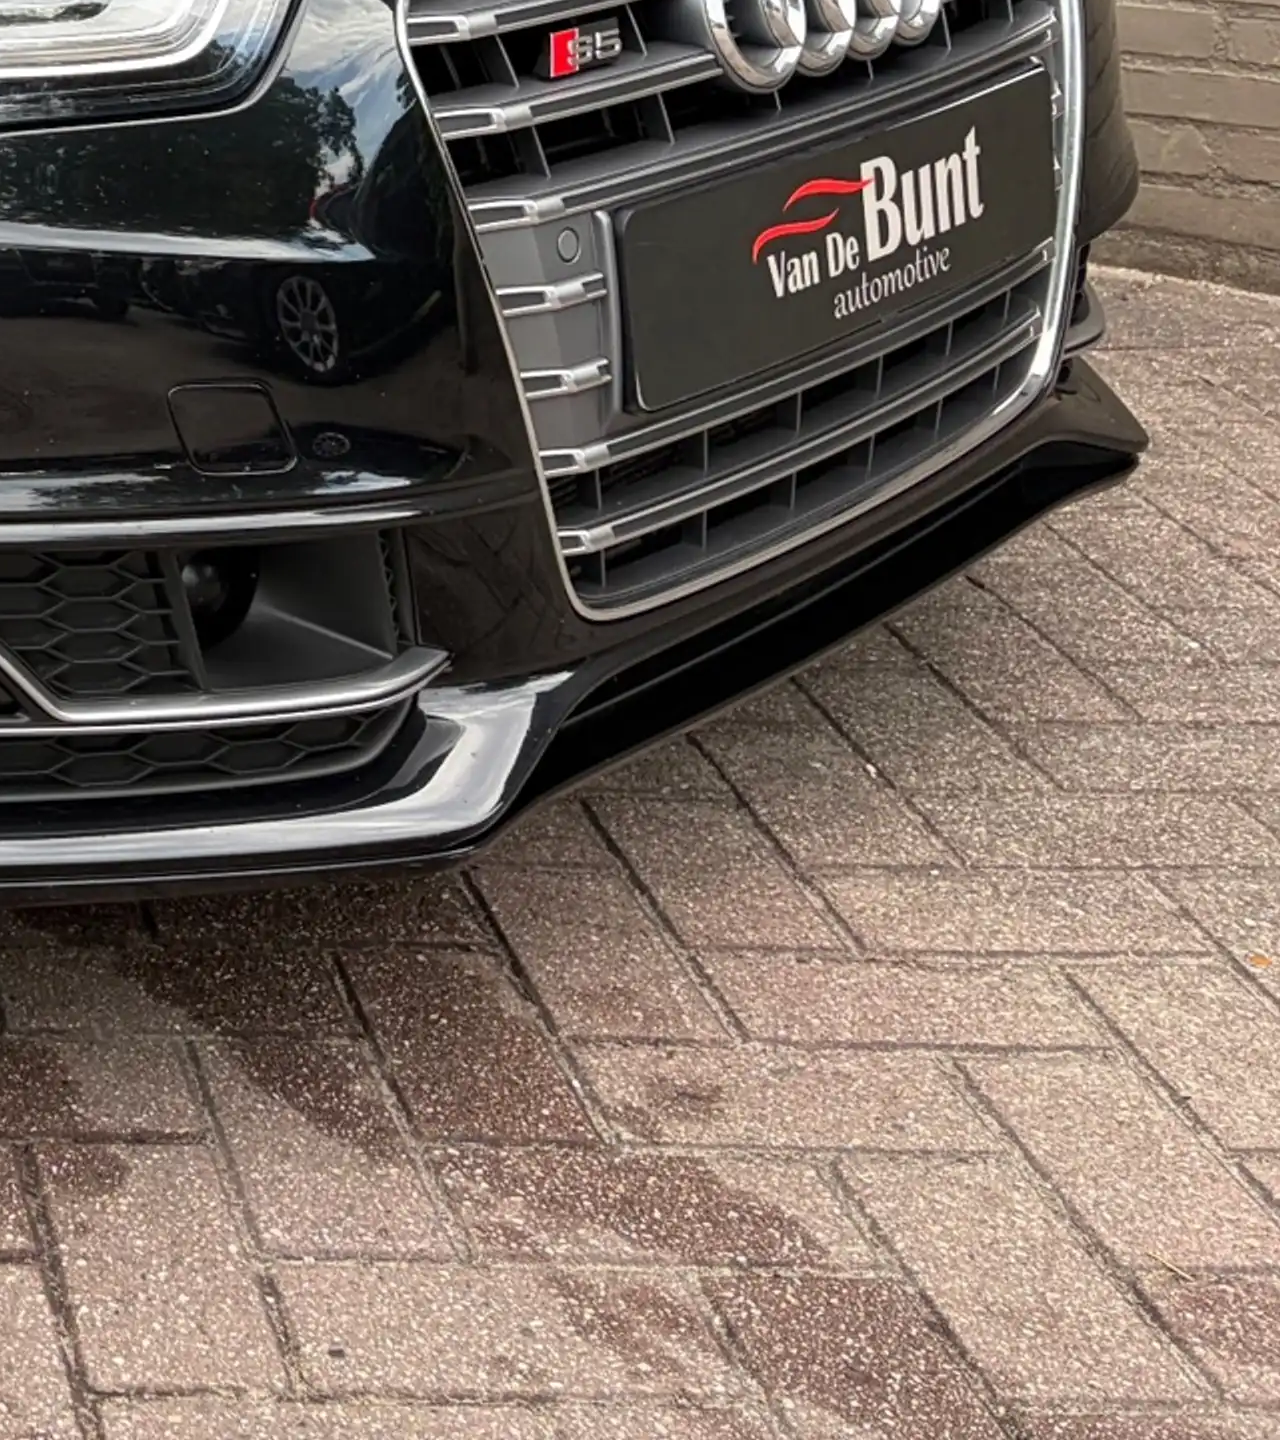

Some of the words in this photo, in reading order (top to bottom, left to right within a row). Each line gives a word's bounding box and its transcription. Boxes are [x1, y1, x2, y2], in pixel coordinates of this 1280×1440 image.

[567, 26, 622, 65] S5
[767, 250, 821, 298] Van
[826, 231, 860, 278] De
[860, 125, 985, 262] Bunt
[833, 245, 951, 319] automotive
